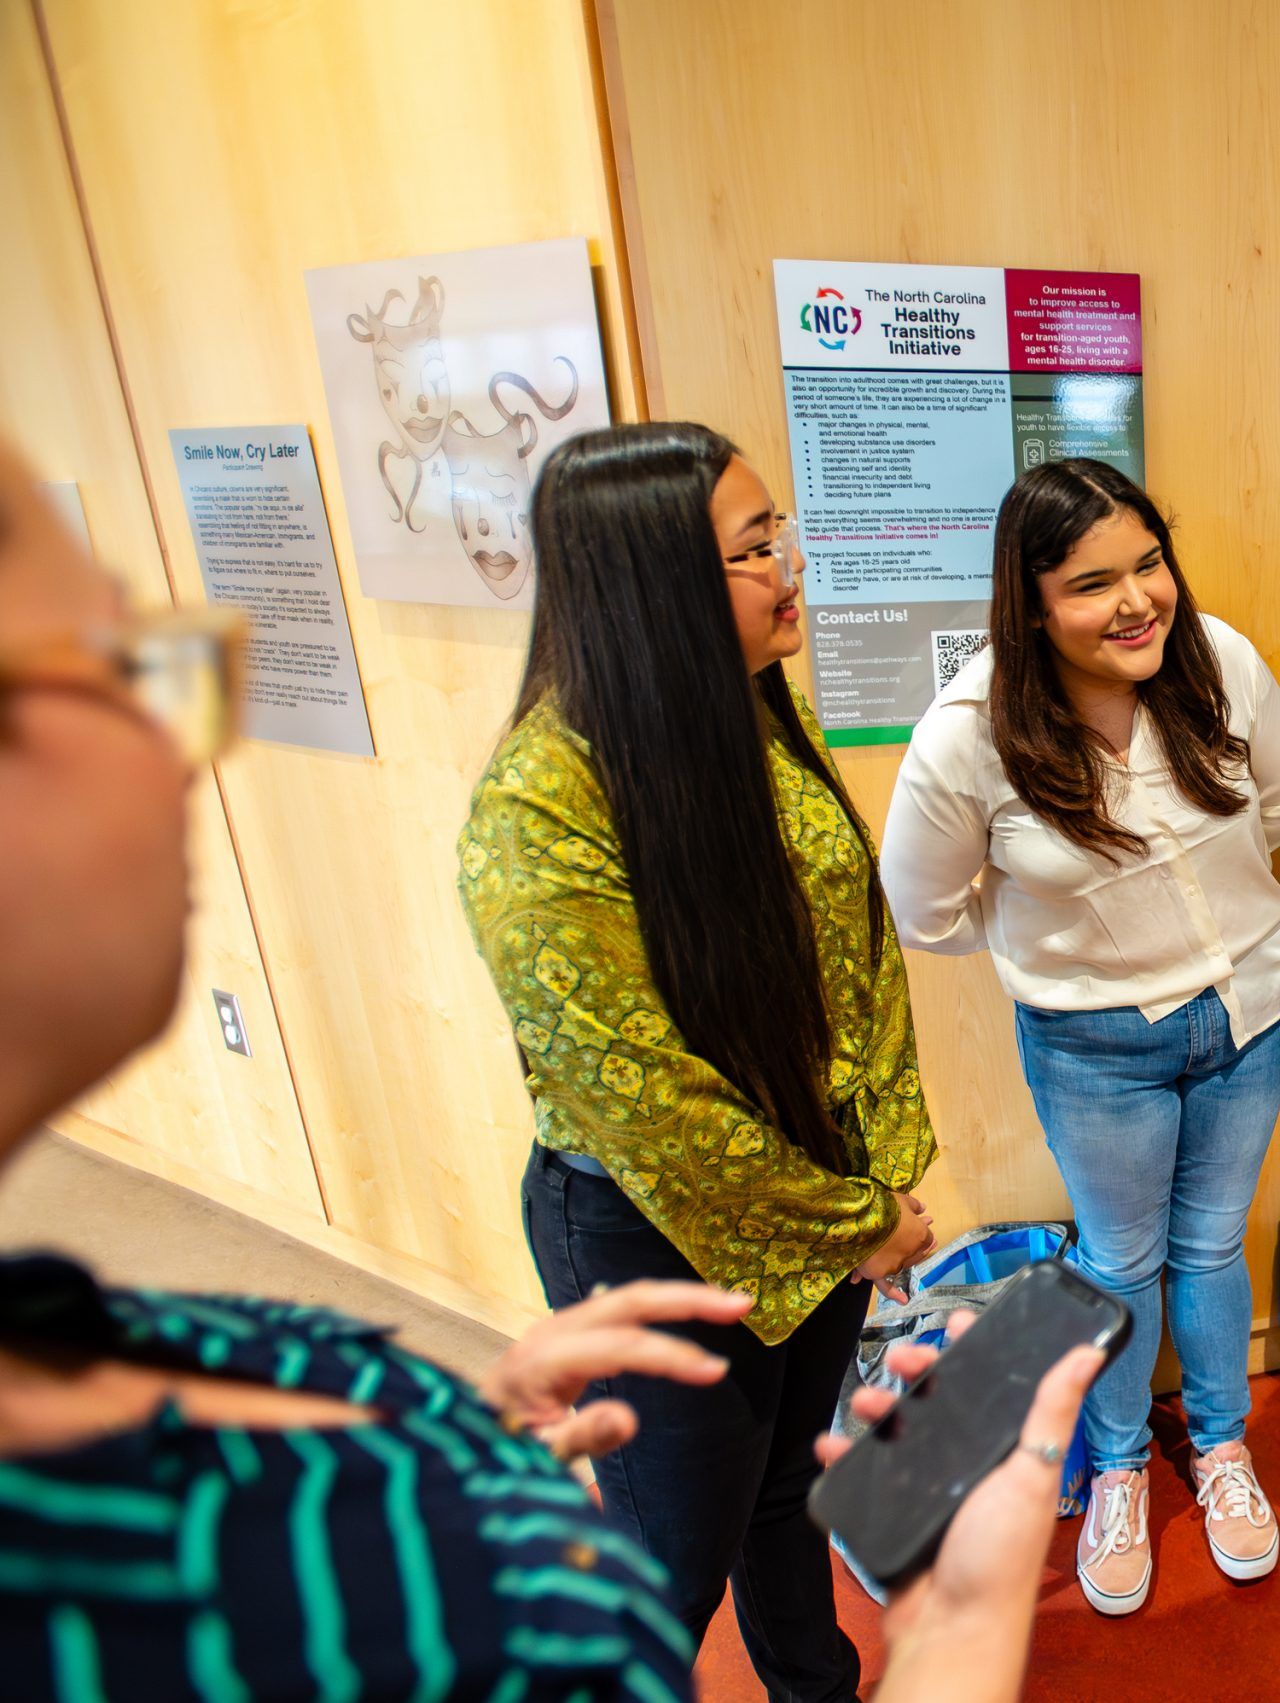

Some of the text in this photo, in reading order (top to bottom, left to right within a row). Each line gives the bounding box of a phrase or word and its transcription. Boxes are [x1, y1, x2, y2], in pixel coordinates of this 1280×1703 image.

[1042, 285, 1060, 295] Our
[1061, 286, 1096, 296] mission
[865, 289, 986, 305] The North Carolina
[1029, 297, 1039, 306] to
[1040, 298, 1076, 308] improve
[1079, 300, 1109, 308] access
[813, 305, 848, 334] NC
[895, 307, 960, 327] Healthy
[1014, 309, 1136, 320] mental health treatment and
[881, 323, 975, 340] Transitions
[1039, 322, 1074, 332] support
[1020, 332, 1130, 345] for transition-aged youth,
[889, 340, 961, 356] Initiative
[1025, 345, 1046, 355] ages
[1048, 344, 1074, 354] 16-25,
[1077, 346, 1100, 356] living
[1103, 346, 1121, 354] with
[1027, 356, 1126, 366] mental health disorder.
[839, 421, 867, 429] changes
[876, 421, 905, 429] physical,
[819, 439, 856, 447] developing
[184, 442, 300, 462] Smile Now, Cry Later
[892, 448, 915, 456] system
[1049, 448, 1077, 457] Clinical
[914, 482, 931, 490] living
[806, 534, 833, 542] Healthy
[816, 609, 908, 625] Contact Us!
[819, 670, 852, 678] Website
[821, 690, 860, 698] Instagram
[823, 710, 861, 719] Facebook
